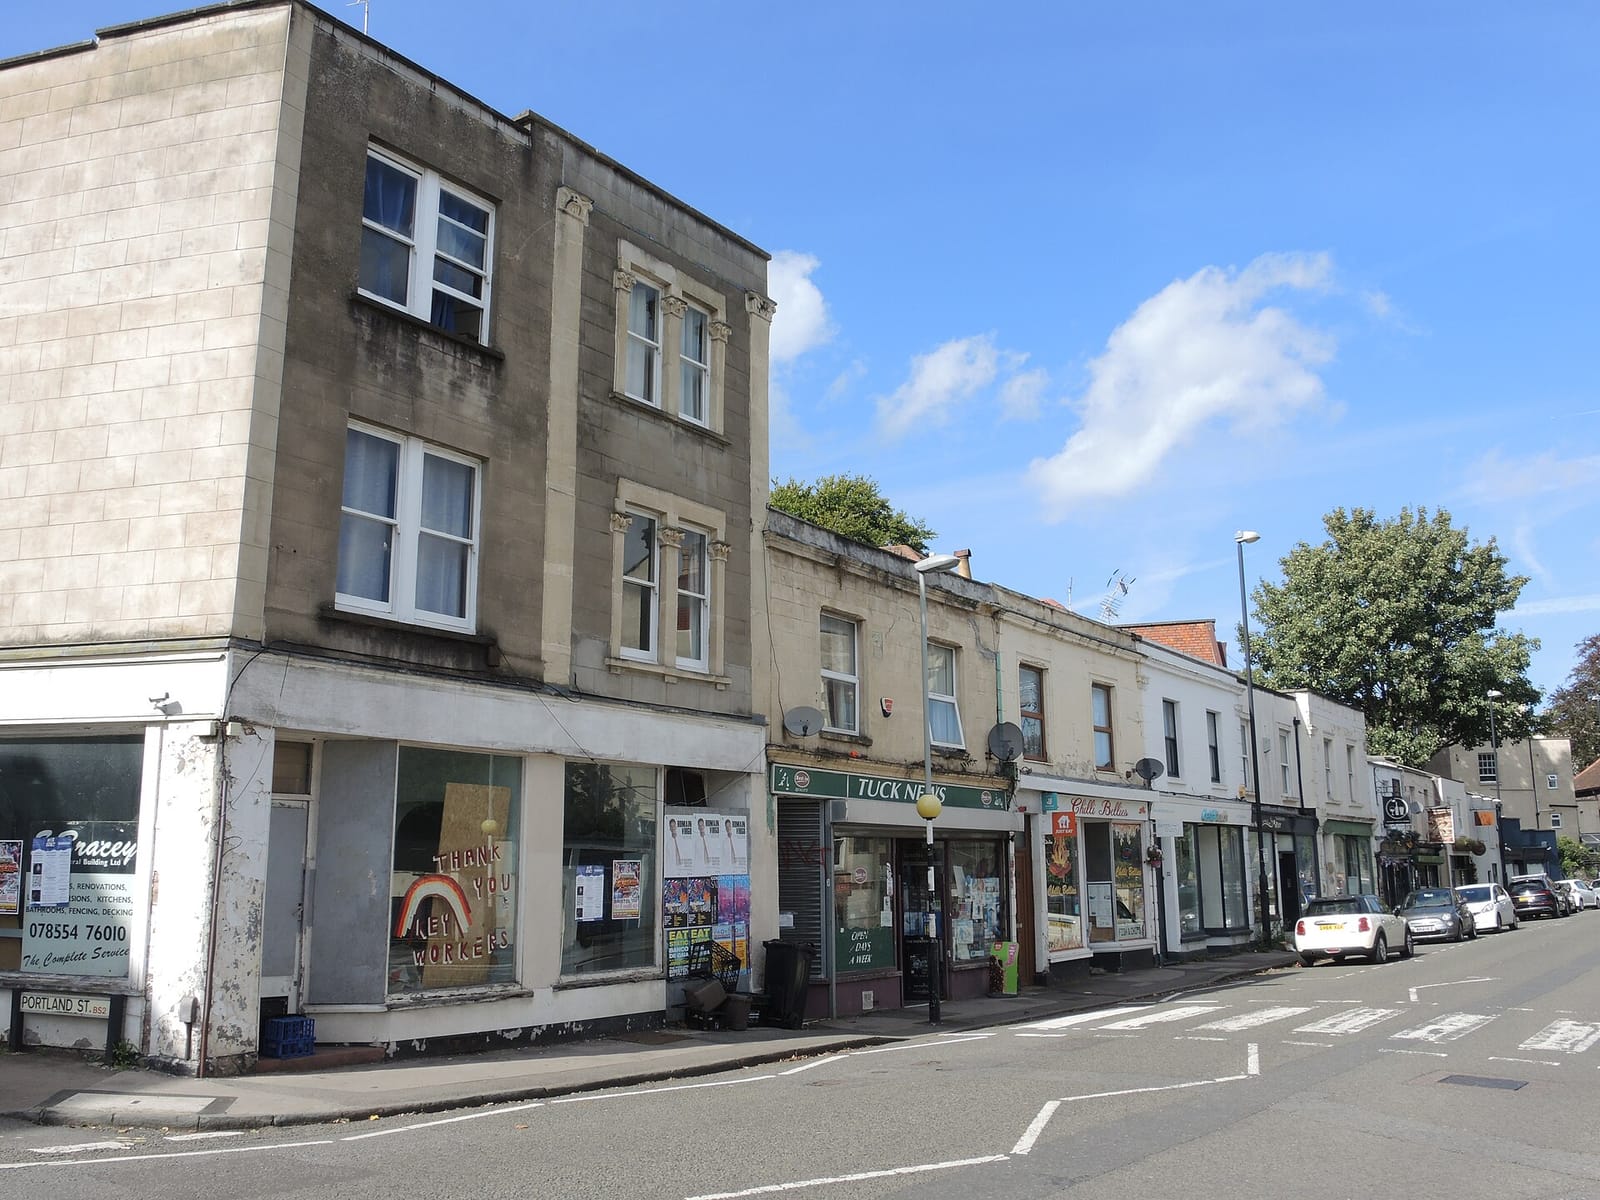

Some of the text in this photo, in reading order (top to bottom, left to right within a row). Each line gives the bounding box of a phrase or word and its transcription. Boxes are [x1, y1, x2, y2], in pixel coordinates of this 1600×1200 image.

[858, 778, 901, 799] TUCK
[1071, 797, 1095, 815] Chilli
[58, 829, 137, 866] racey
[83, 858, 108, 867] Building
[432, 846, 501, 873] THANK
[77, 883, 128, 891] RENOVATIONS,
[473, 873, 511, 900] YOU
[69, 895, 134, 904] SIONS, KITCHENS,
[25, 906, 133, 916] BATHROOMS, FENCING, DECKING
[29, 922, 127, 941] 078554 76010
[414, 913, 450, 940] KEY
[669, 930, 689, 941] EAT
[691, 928, 711, 939] EAT
[851, 930, 870, 941] OPEN
[412, 930, 509, 967] WORKERS
[855, 941, 872, 952] DAYS
[23, 947, 129, 967] The Complete Service
[855, 954, 872, 964] WEEK
[21, 996, 73, 1012] PORTLAND
[92, 1006, 107, 1015] BS2
